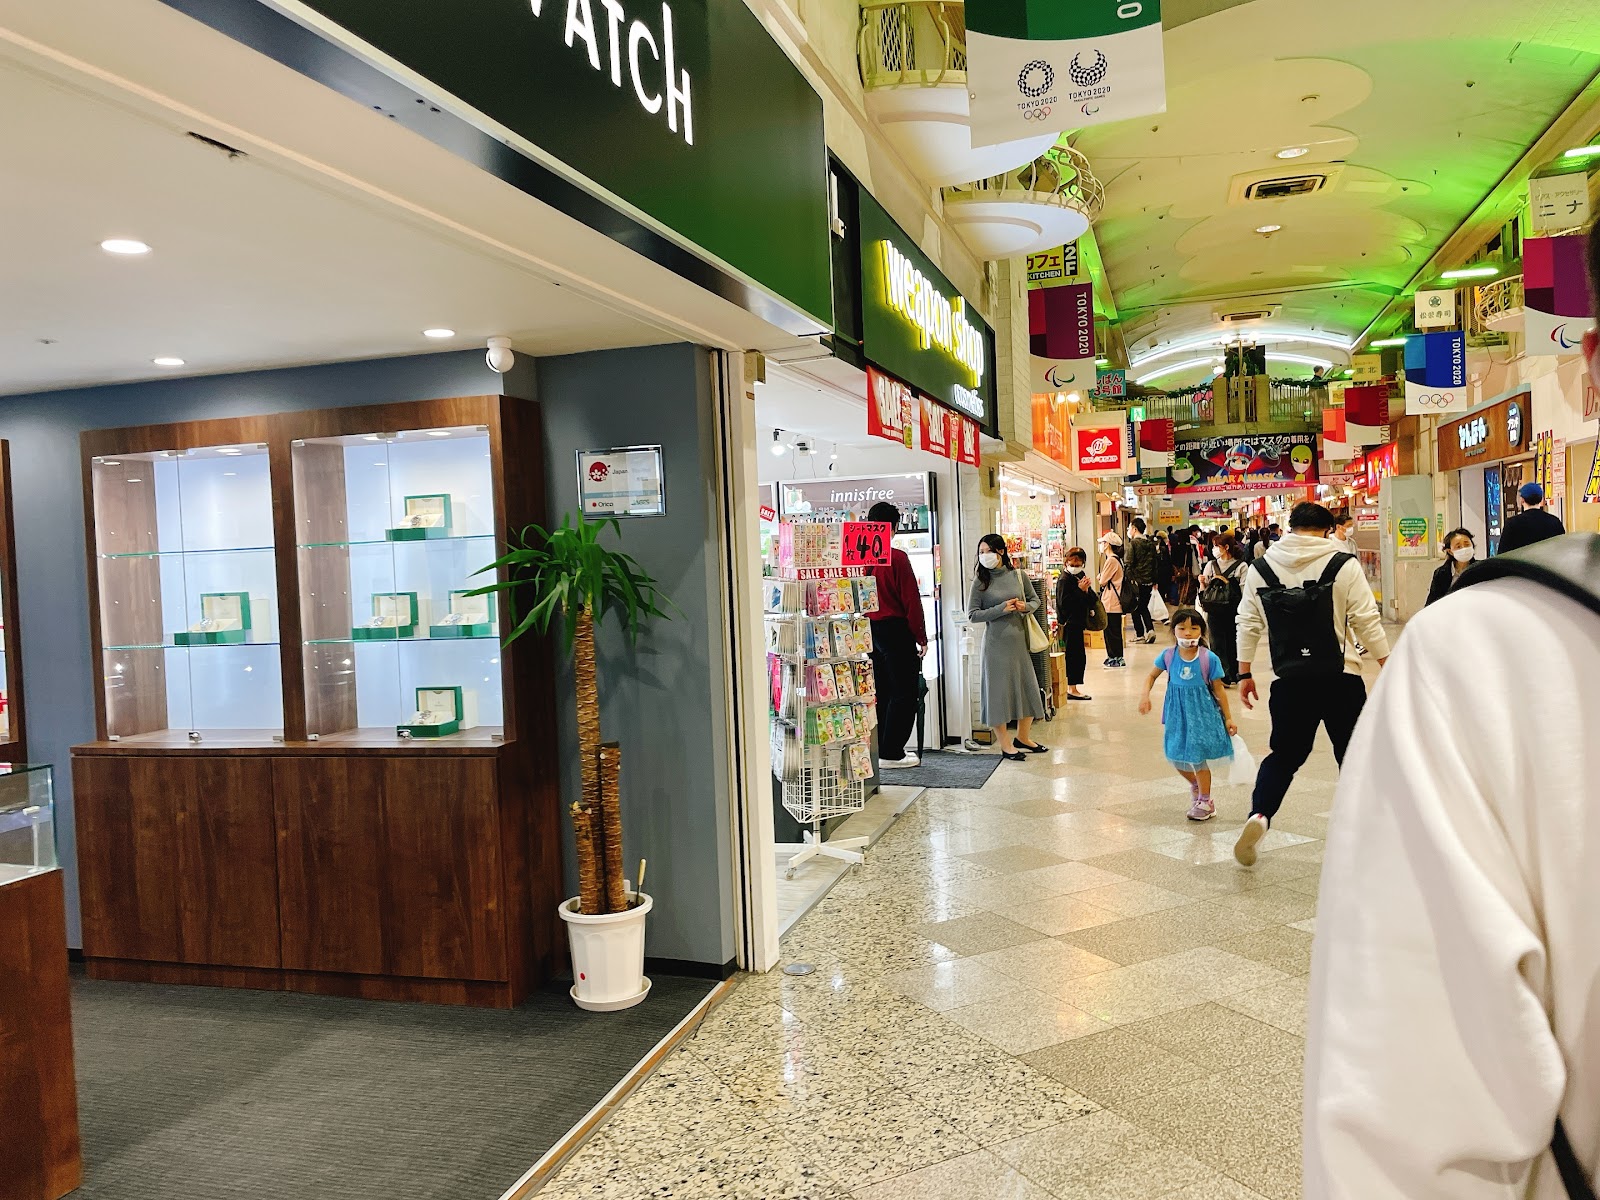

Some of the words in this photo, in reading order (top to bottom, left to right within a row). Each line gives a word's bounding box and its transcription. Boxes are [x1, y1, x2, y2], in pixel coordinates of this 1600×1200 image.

[531, 0, 694, 146] ATCH
[1069, 89, 1092, 100] TOKYO
[1093, 86, 1111, 95] 2020
[1017, 99, 1040, 110] TOKYO
[1040, 96, 1058, 106] 2020
[1027, 270, 1061, 281] KITCHEN
[881, 239, 953, 353] weapon
[953, 295, 985, 388] shop
[1076, 292, 1089, 328] TOKYO
[1078, 329, 1090, 355] 2020
[1452, 336, 1462, 365] TOKYO
[1453, 365, 1462, 386] 2020
[1207, 473, 1236, 484] WEAR
[1237, 474, 1244, 483] A
[830, 487, 895, 503] innisfree
[760, 508, 774, 518] SALE
[850, 524, 886, 533] シートマスク
[856, 534, 883, 560] 40
[801, 569, 820, 580] SALE
[824, 568, 844, 579] SALE
[847, 567, 864, 578] SALE
